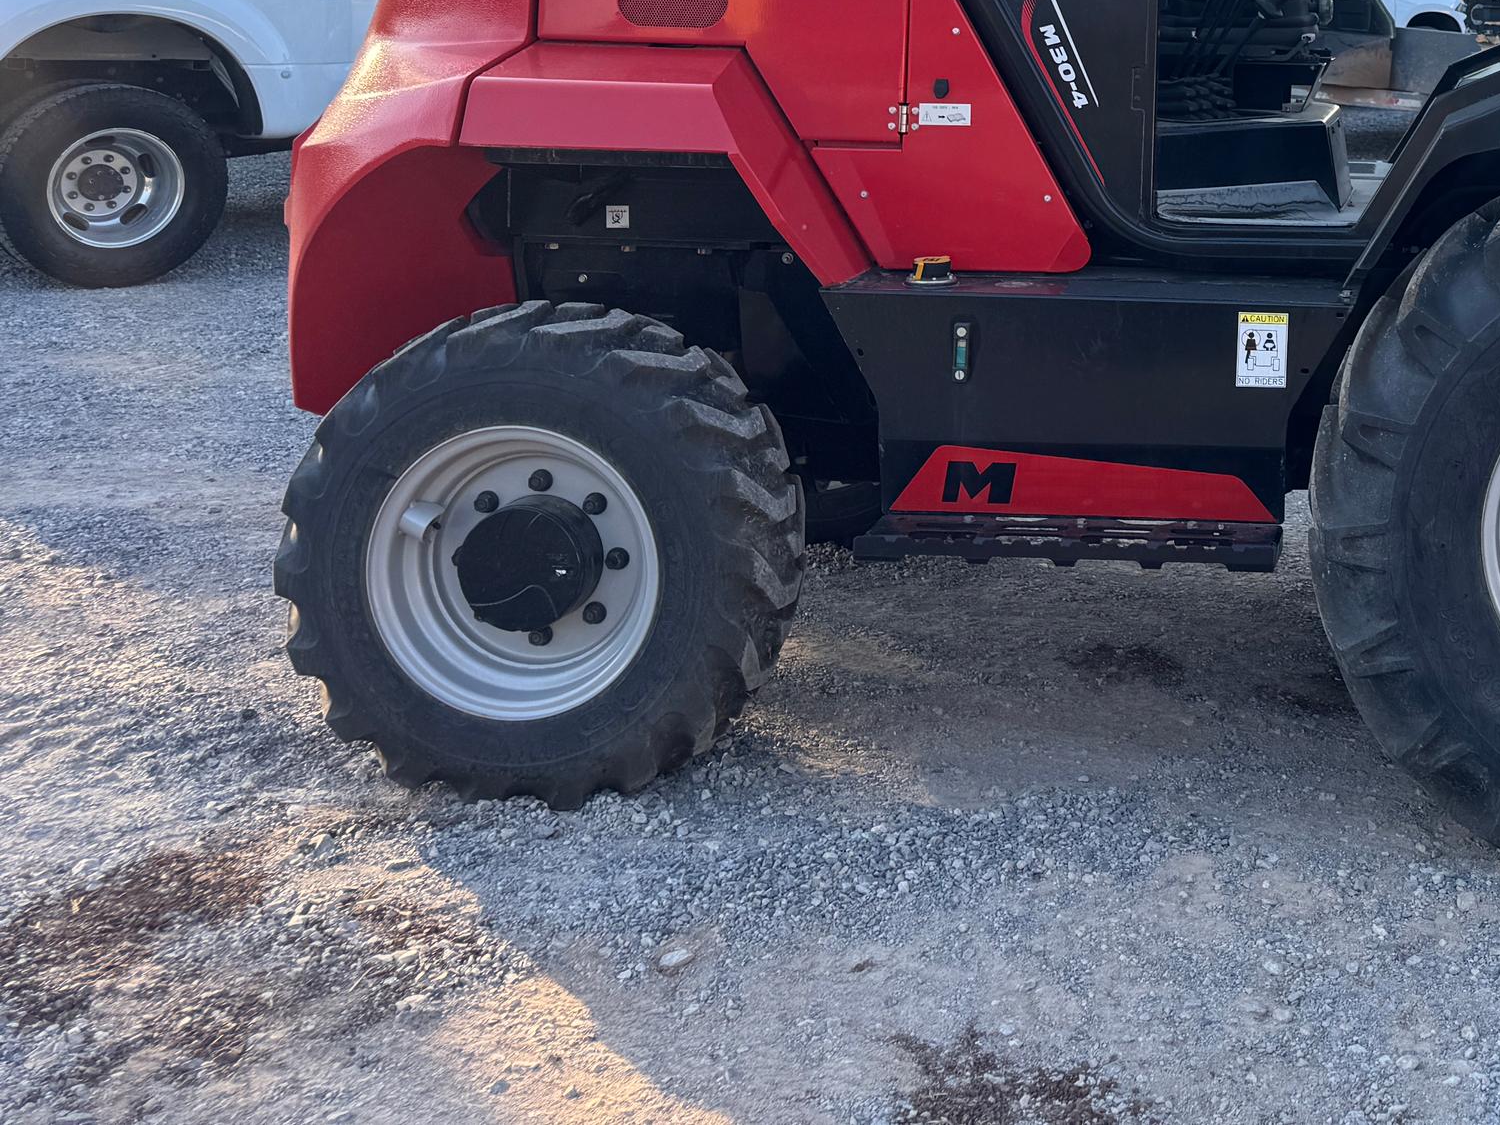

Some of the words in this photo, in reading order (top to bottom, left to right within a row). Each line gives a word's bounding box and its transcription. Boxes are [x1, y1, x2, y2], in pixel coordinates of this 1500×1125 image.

[1039, 24, 1089, 109] M30-4
[1250, 315, 1285, 323] CAUTION
[1238, 377, 1250, 385] NO
[1254, 377, 1284, 386] RIDERS
[942, 461, 1017, 504] M
